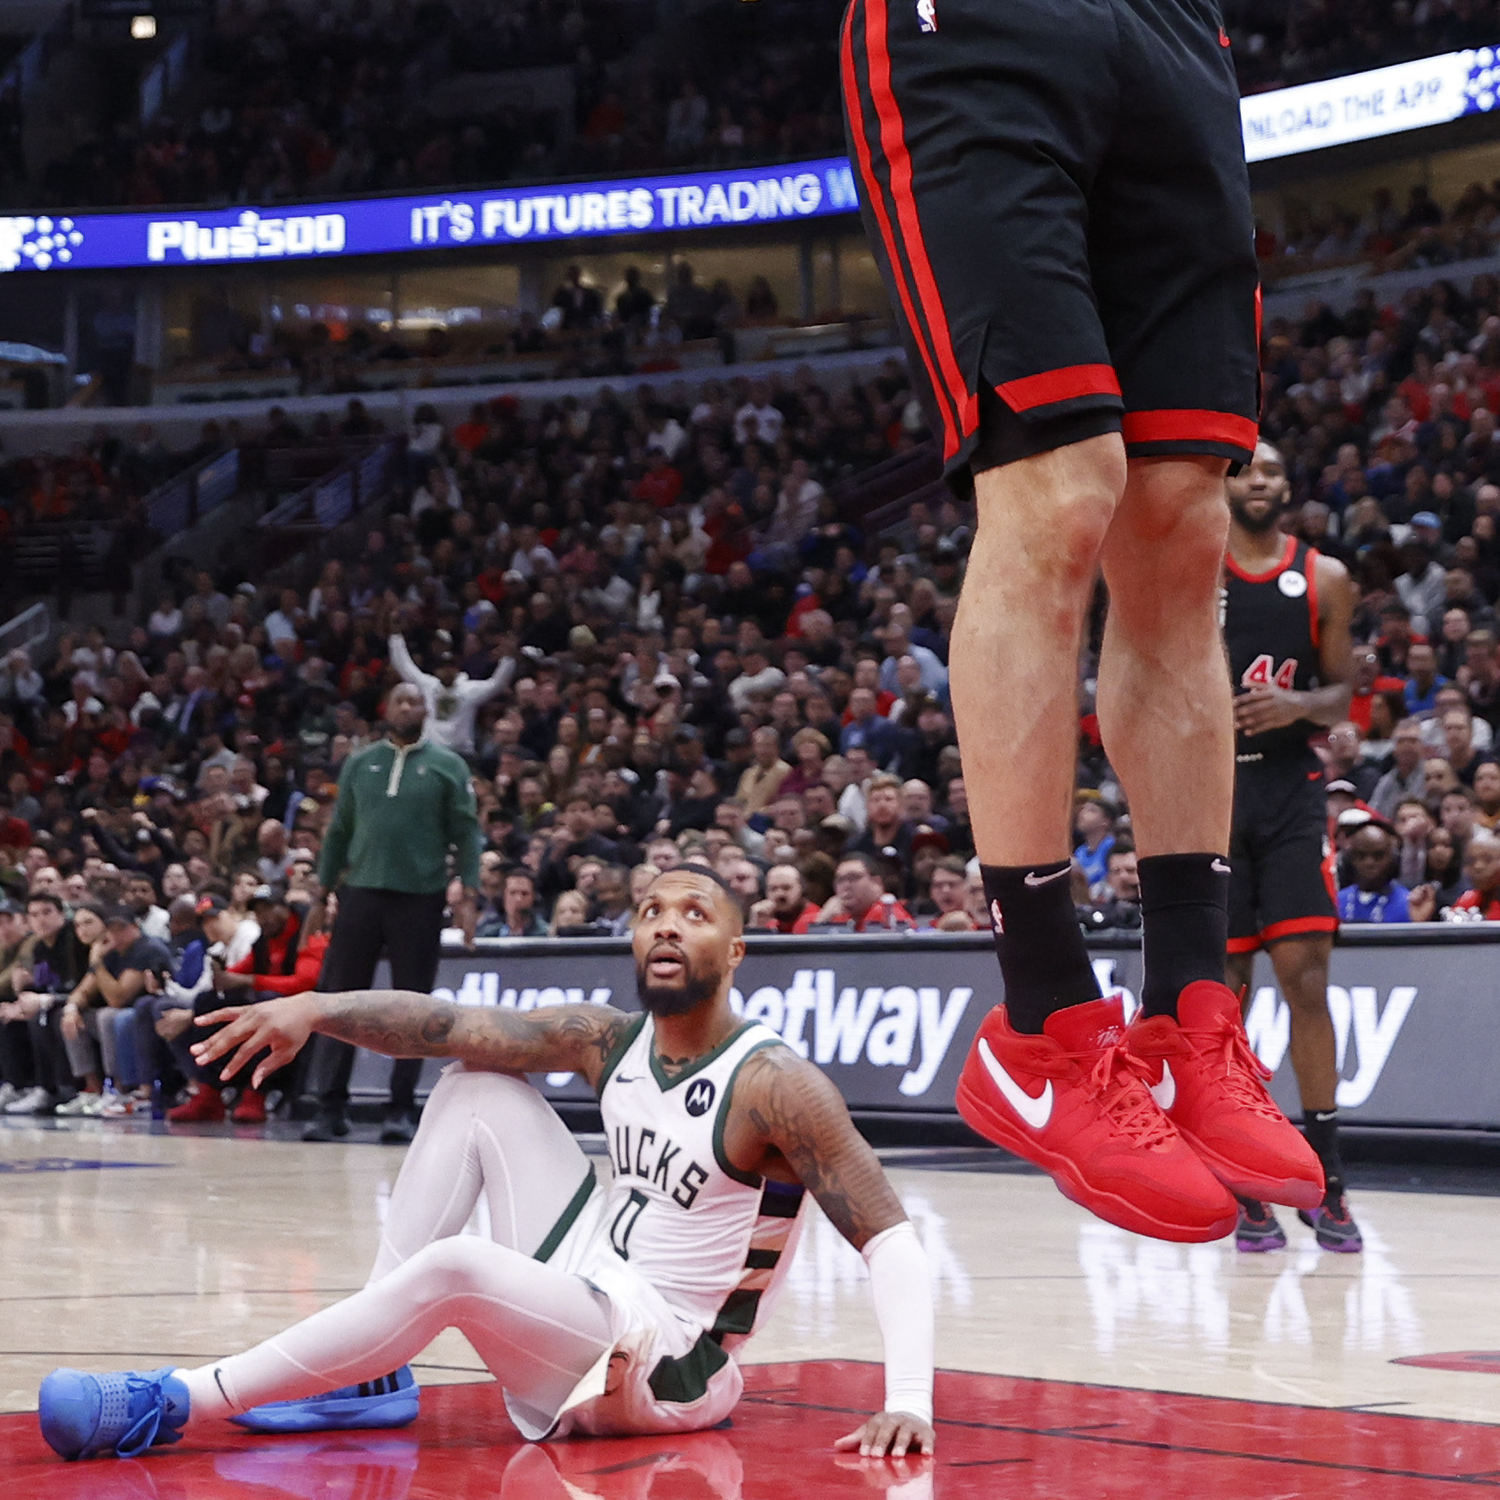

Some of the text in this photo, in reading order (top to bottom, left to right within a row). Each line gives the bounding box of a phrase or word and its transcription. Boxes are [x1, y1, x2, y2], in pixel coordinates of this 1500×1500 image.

[1245, 78, 1443, 143] NLOAD THE APP
[148, 210, 346, 262] Plus500
[411, 199, 473, 244] IT'S
[481, 188, 653, 237] FUTURES
[655, 172, 821, 228] TRADING
[726, 969, 974, 1097] etway
[613, 1125, 709, 1210] UCKS
[610, 1188, 650, 1262] 0
